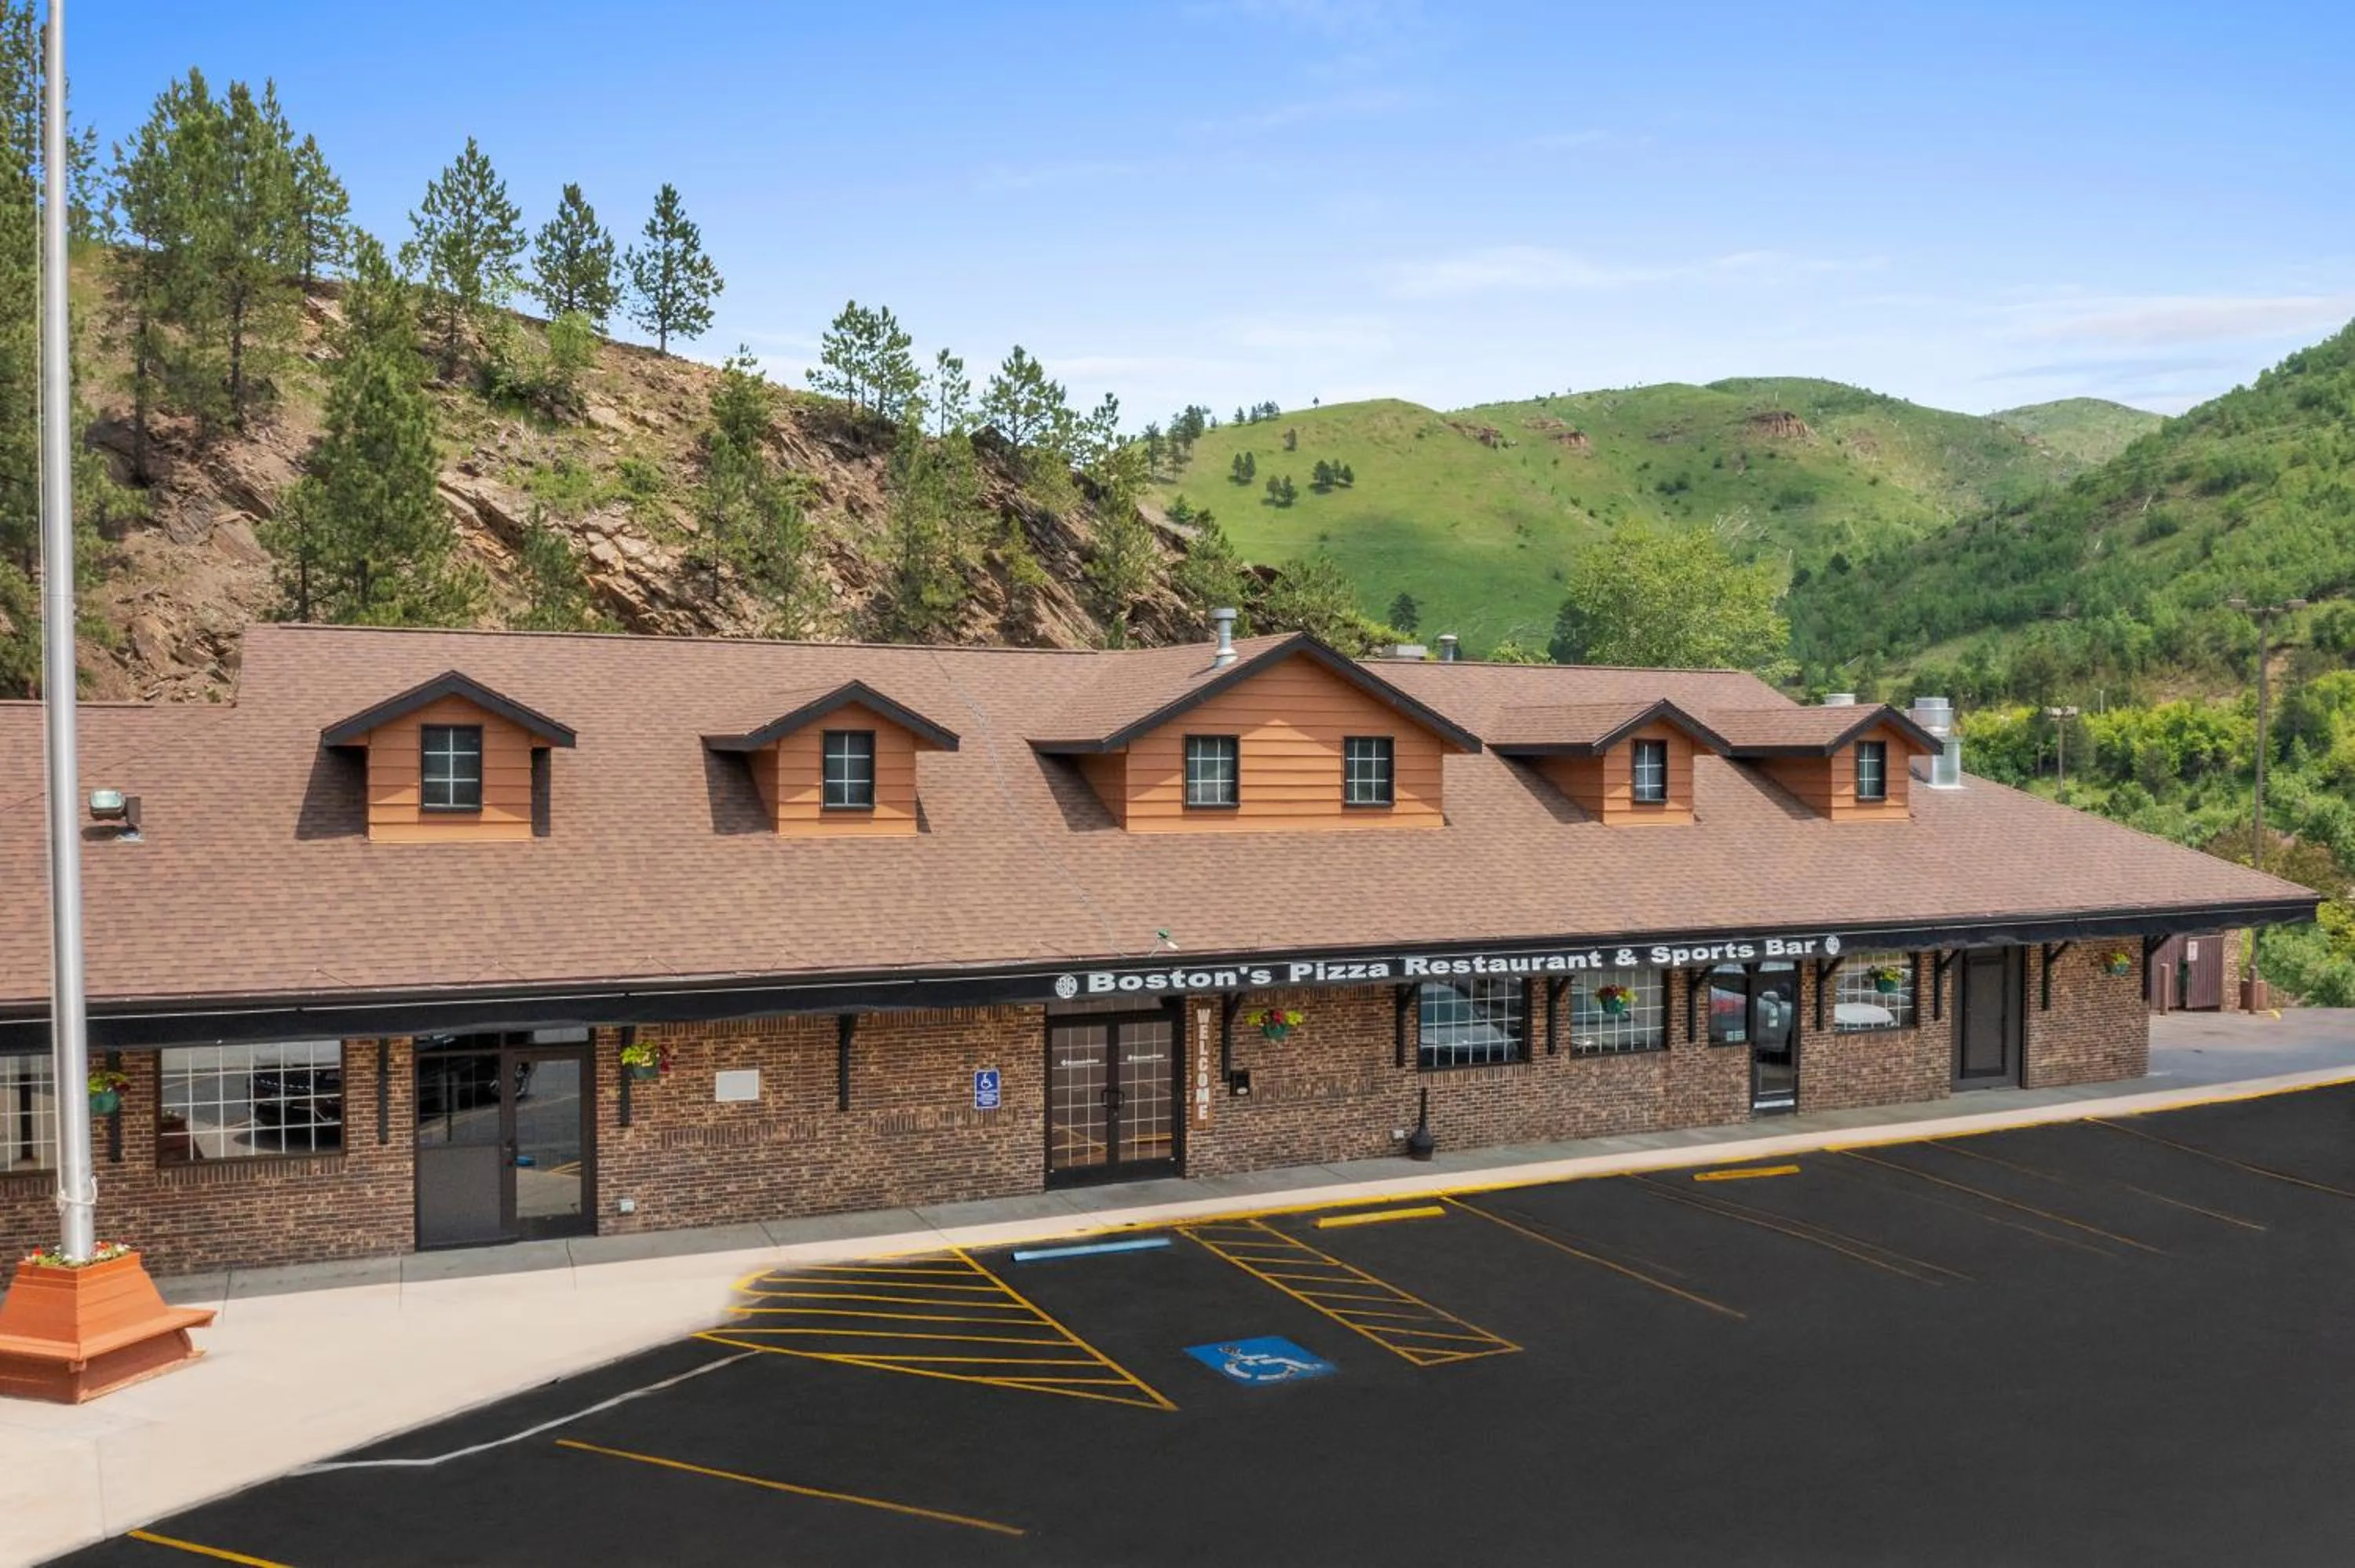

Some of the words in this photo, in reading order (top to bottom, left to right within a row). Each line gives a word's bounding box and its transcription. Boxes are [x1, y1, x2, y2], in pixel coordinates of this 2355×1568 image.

[1088, 966, 1272, 993] Boston's
[1290, 961, 1389, 982] Pizza
[1403, 950, 1602, 975] Restaurant
[1615, 949, 1638, 966] &
[1652, 943, 1755, 967] Sports
[1765, 939, 1816, 955] Bar
[1196, 1008, 1210, 1119] WELCOME
